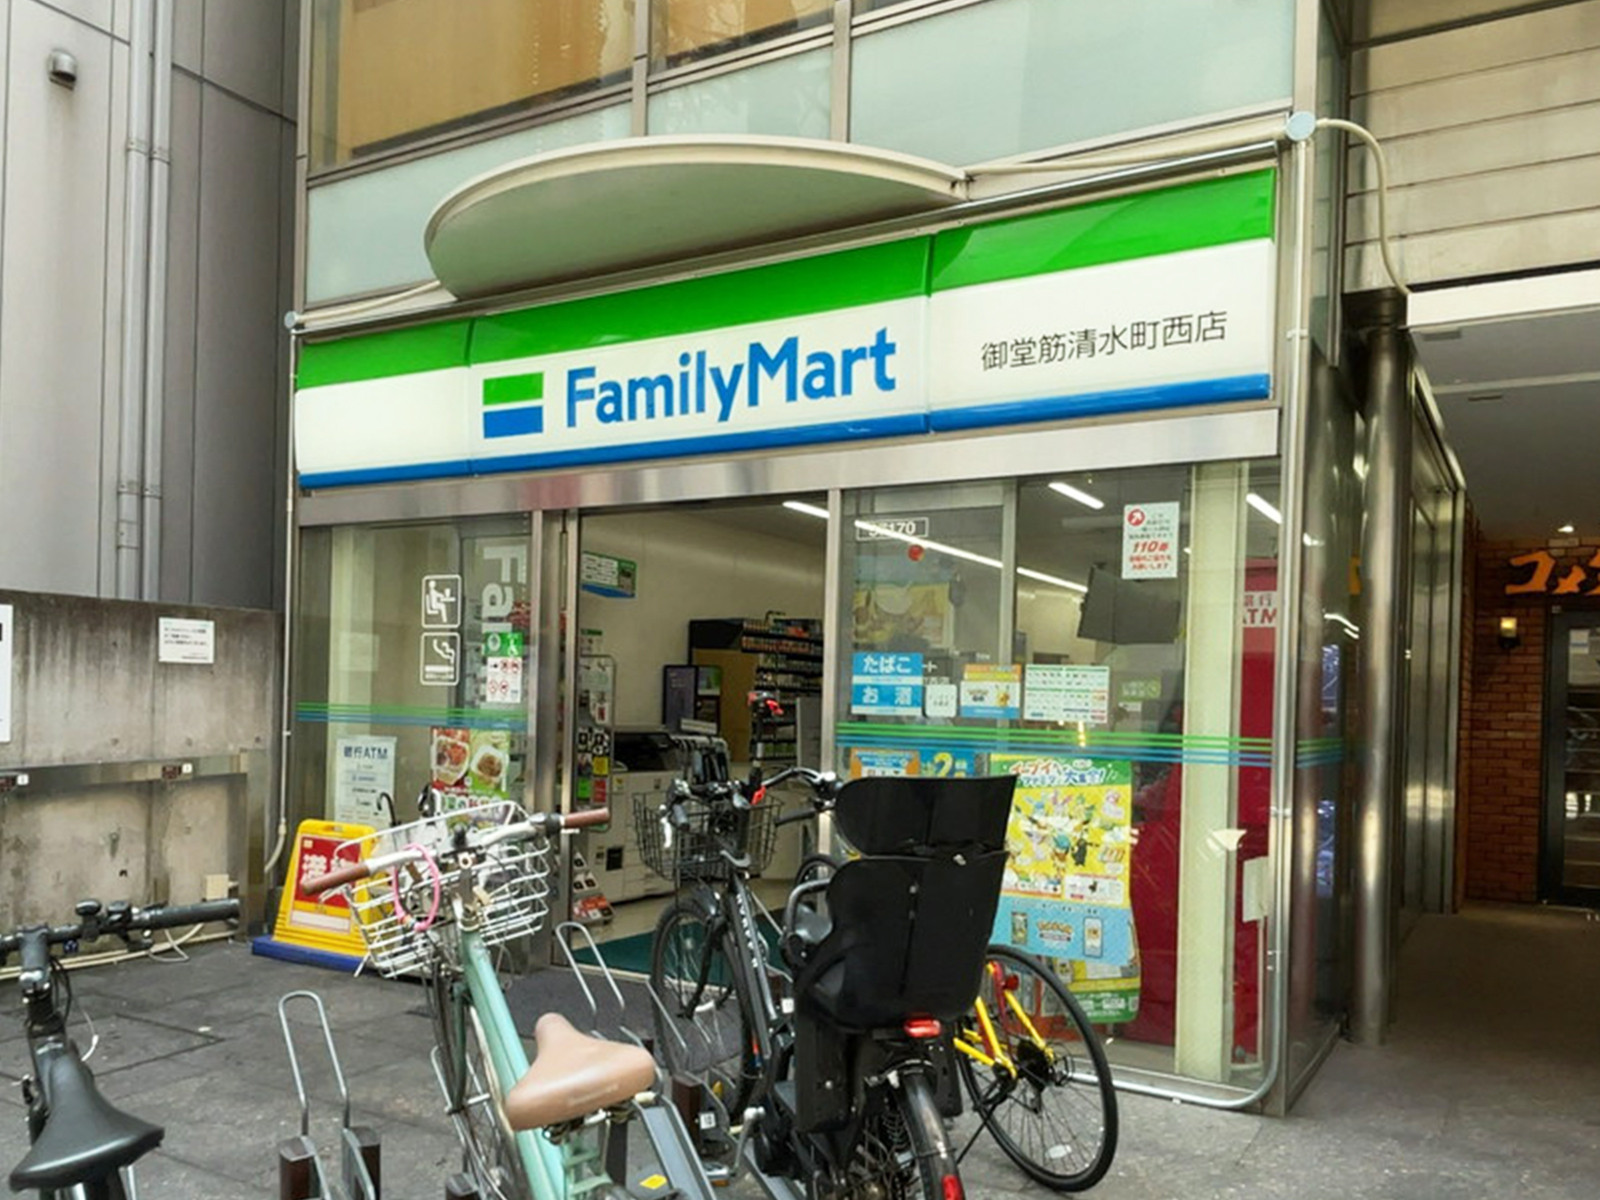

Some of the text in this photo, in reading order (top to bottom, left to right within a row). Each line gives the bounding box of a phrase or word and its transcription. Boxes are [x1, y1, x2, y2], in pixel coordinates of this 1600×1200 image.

[981, 310, 1227, 371] 御堂筋清水町西店
[567, 327, 896, 428] FamilyMart
[863, 654, 912, 674] たばこ
